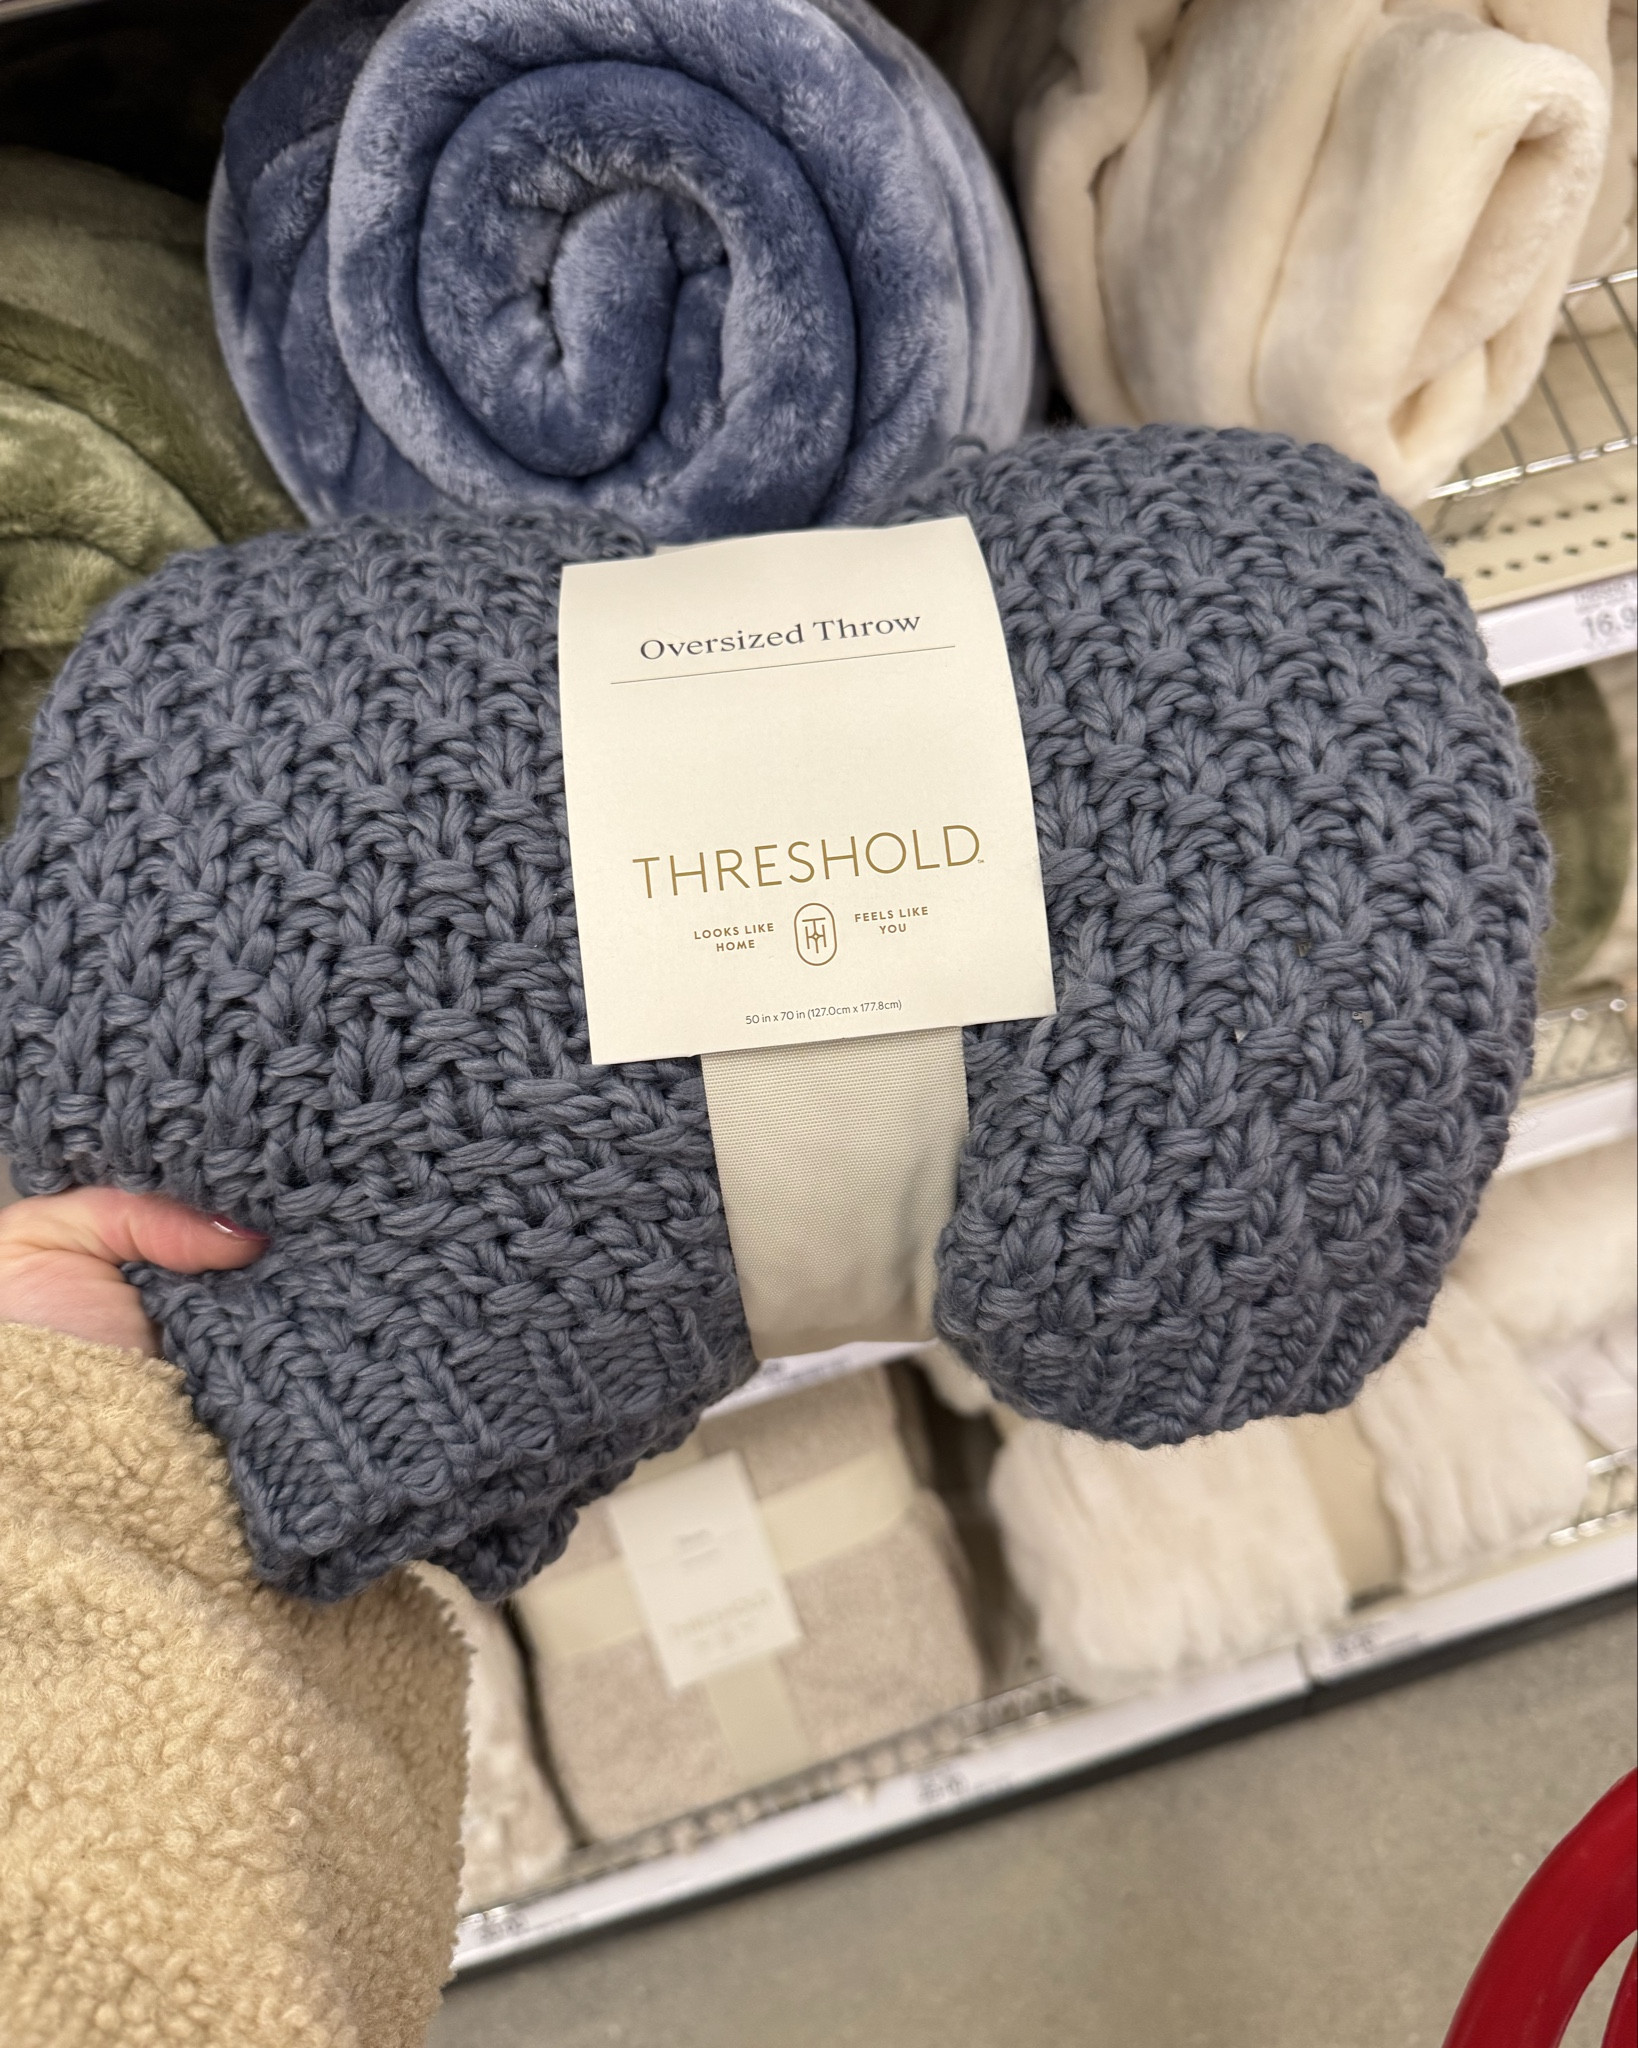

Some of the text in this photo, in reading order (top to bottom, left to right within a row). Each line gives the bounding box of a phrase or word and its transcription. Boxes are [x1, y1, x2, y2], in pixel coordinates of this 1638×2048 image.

[640, 617, 921, 660] Oversized Throw
[632, 824, 981, 899] THRESHOLD
[854, 906, 929, 923] FEELS LIKE
[694, 923, 775, 940] LOOKS LIKE
[879, 923, 907, 935] YOU
[716, 939, 756, 953] HOME
[746, 999, 902, 1025] 50 in x 70 in (127.0cm x 177.8cm)
